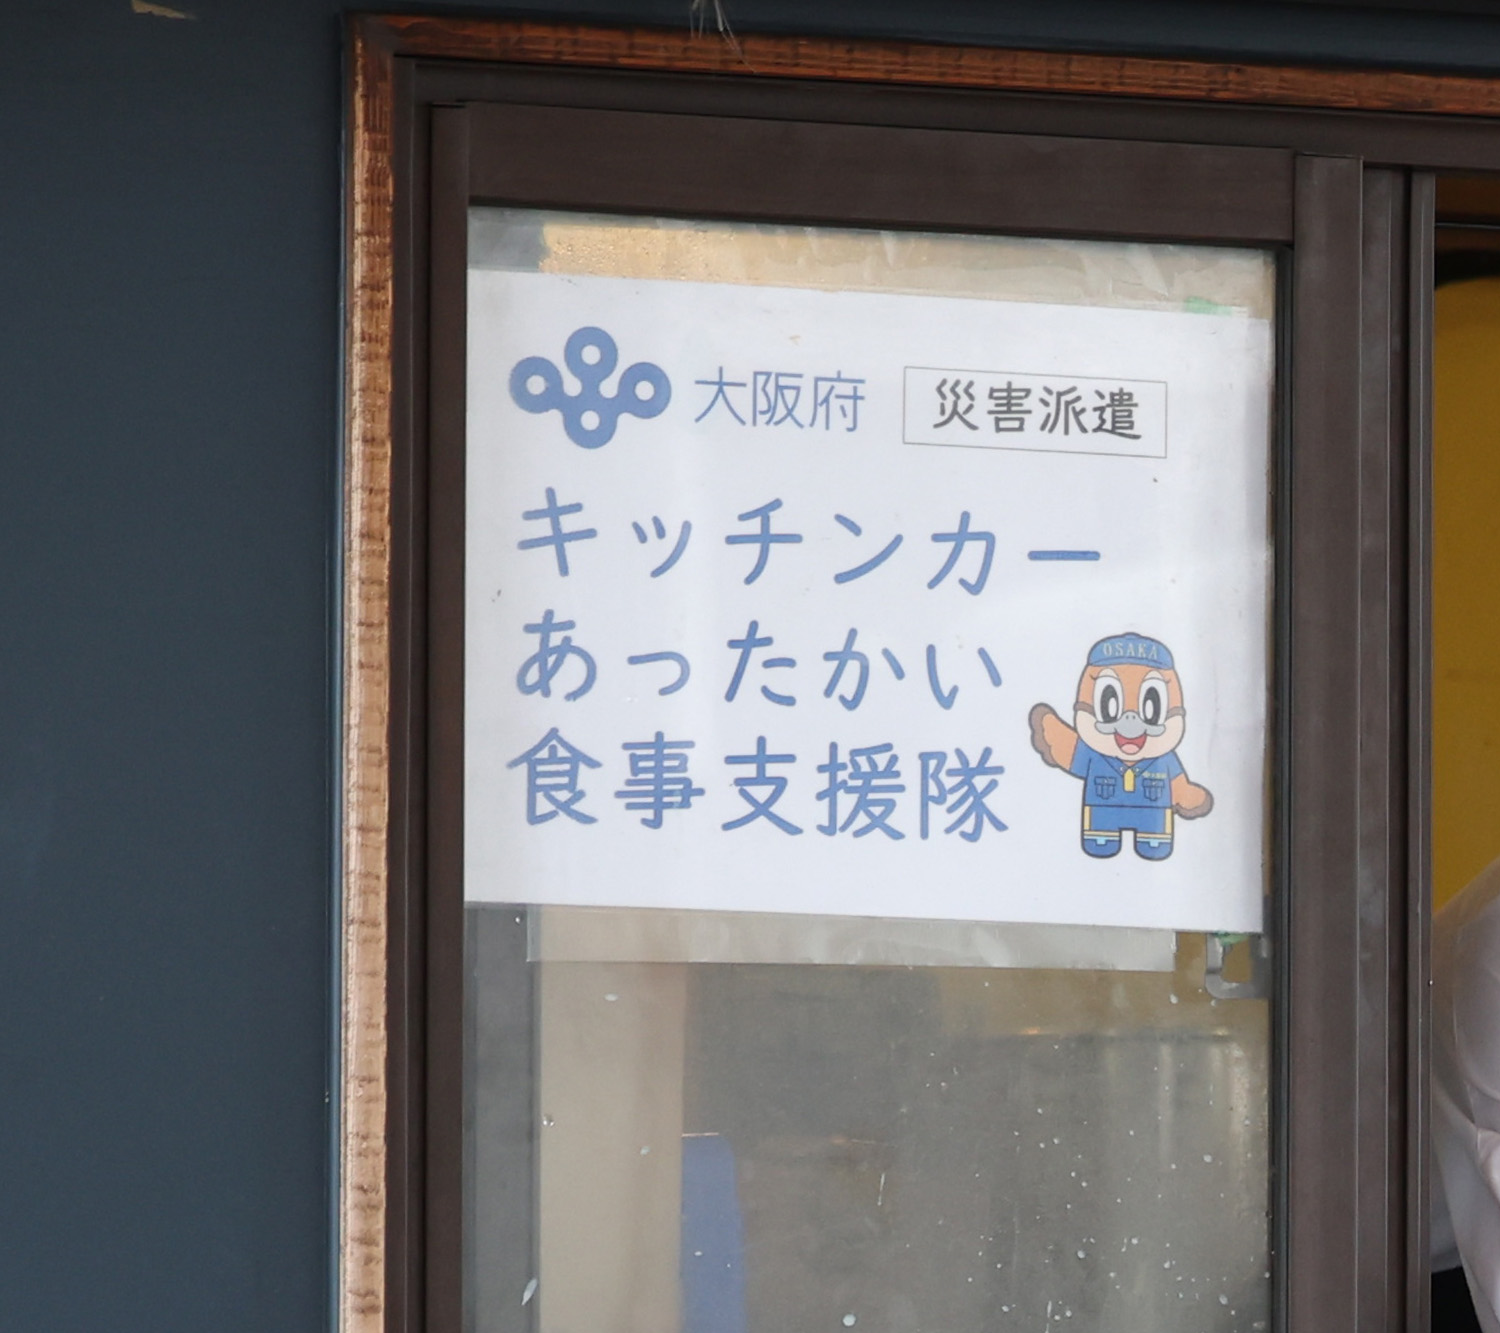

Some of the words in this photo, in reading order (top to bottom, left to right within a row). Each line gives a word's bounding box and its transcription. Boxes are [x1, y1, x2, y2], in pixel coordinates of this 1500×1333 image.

[694, 366, 867, 433] 大阪府
[931, 378, 1143, 442] 災害派遣
[517, 487, 1101, 596] キッチンカー
[516, 609, 1003, 712] あったかい
[1102, 643, 1159, 660] OSAKA
[506, 727, 1009, 844] 食事支援隊
